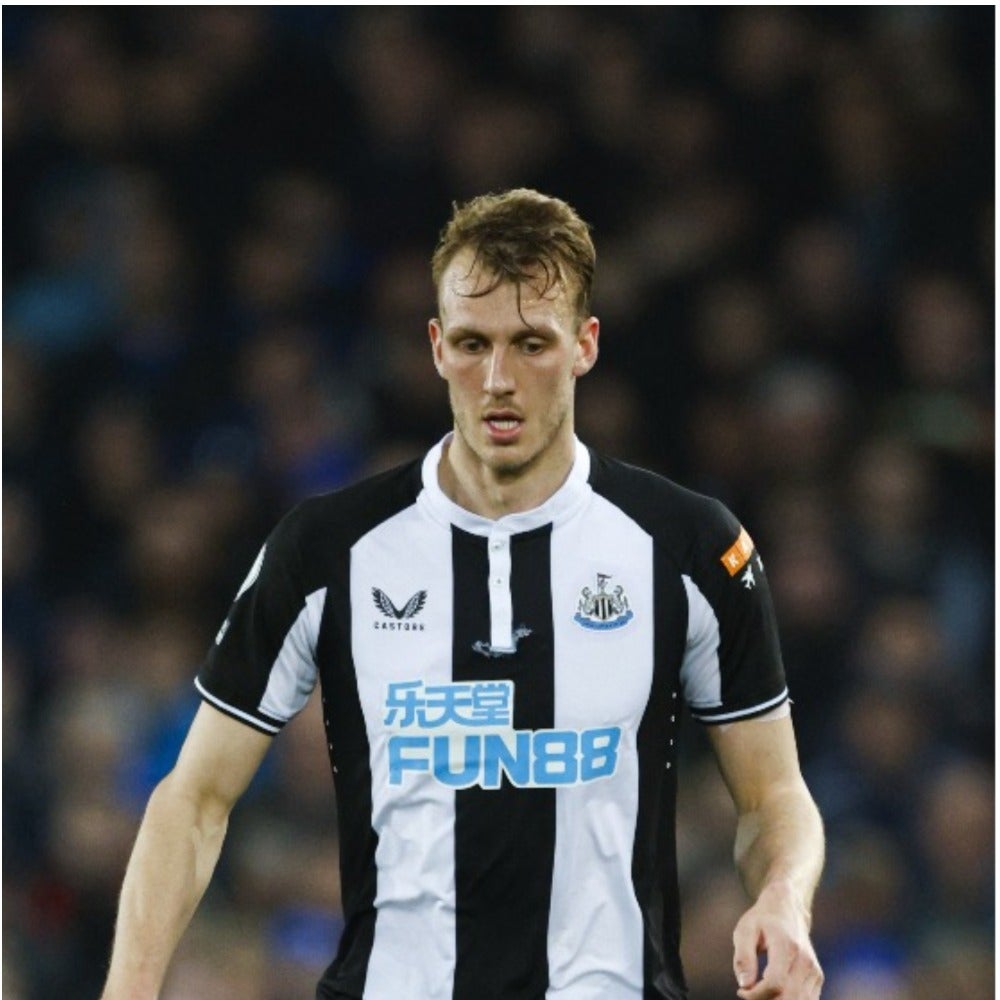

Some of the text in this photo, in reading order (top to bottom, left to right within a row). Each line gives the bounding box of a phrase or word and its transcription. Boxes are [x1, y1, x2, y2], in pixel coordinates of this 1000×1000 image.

[383, 680, 511, 728] 乐天堂
[388, 727, 622, 787] FUN88
